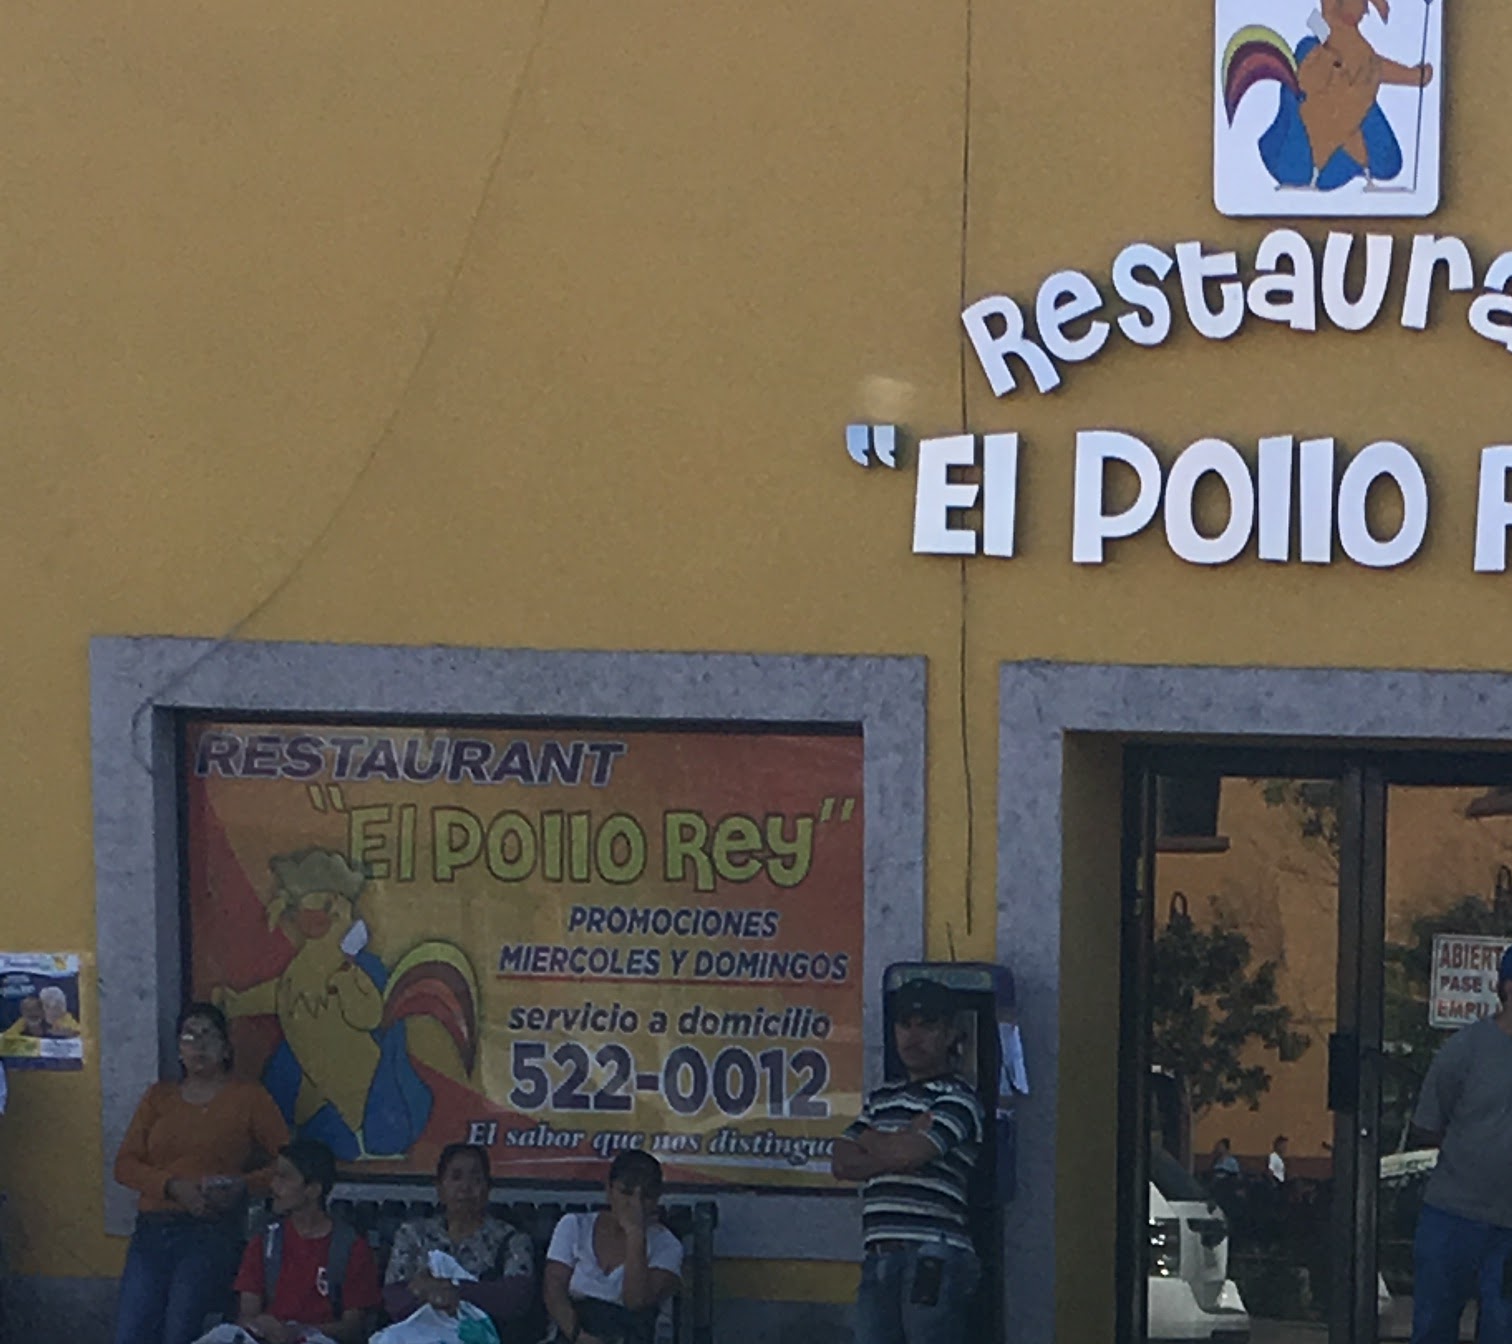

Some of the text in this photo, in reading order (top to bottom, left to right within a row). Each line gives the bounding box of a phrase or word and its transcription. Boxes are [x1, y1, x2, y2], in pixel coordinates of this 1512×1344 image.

[1071, 429, 1428, 566] Pollo
[196, 734, 627, 788] RESTAURANT
[432, 806, 647, 885] Pollo
[568, 905, 780, 938] PROMOCIONES
[498, 945, 850, 982] MIERCOLES Y DOMINGOS
[1438, 943, 1503, 971] ABIERT
[1439, 975, 1483, 994] PASE
[507, 1002, 832, 1040] servicio a domicilio
[508, 1040, 833, 1120] 522-0012
[466, 1121, 498, 1147] El
[505, 1122, 586, 1149] sabor
[591, 1132, 643, 1157] que
[651, 1133, 700, 1151] nos
